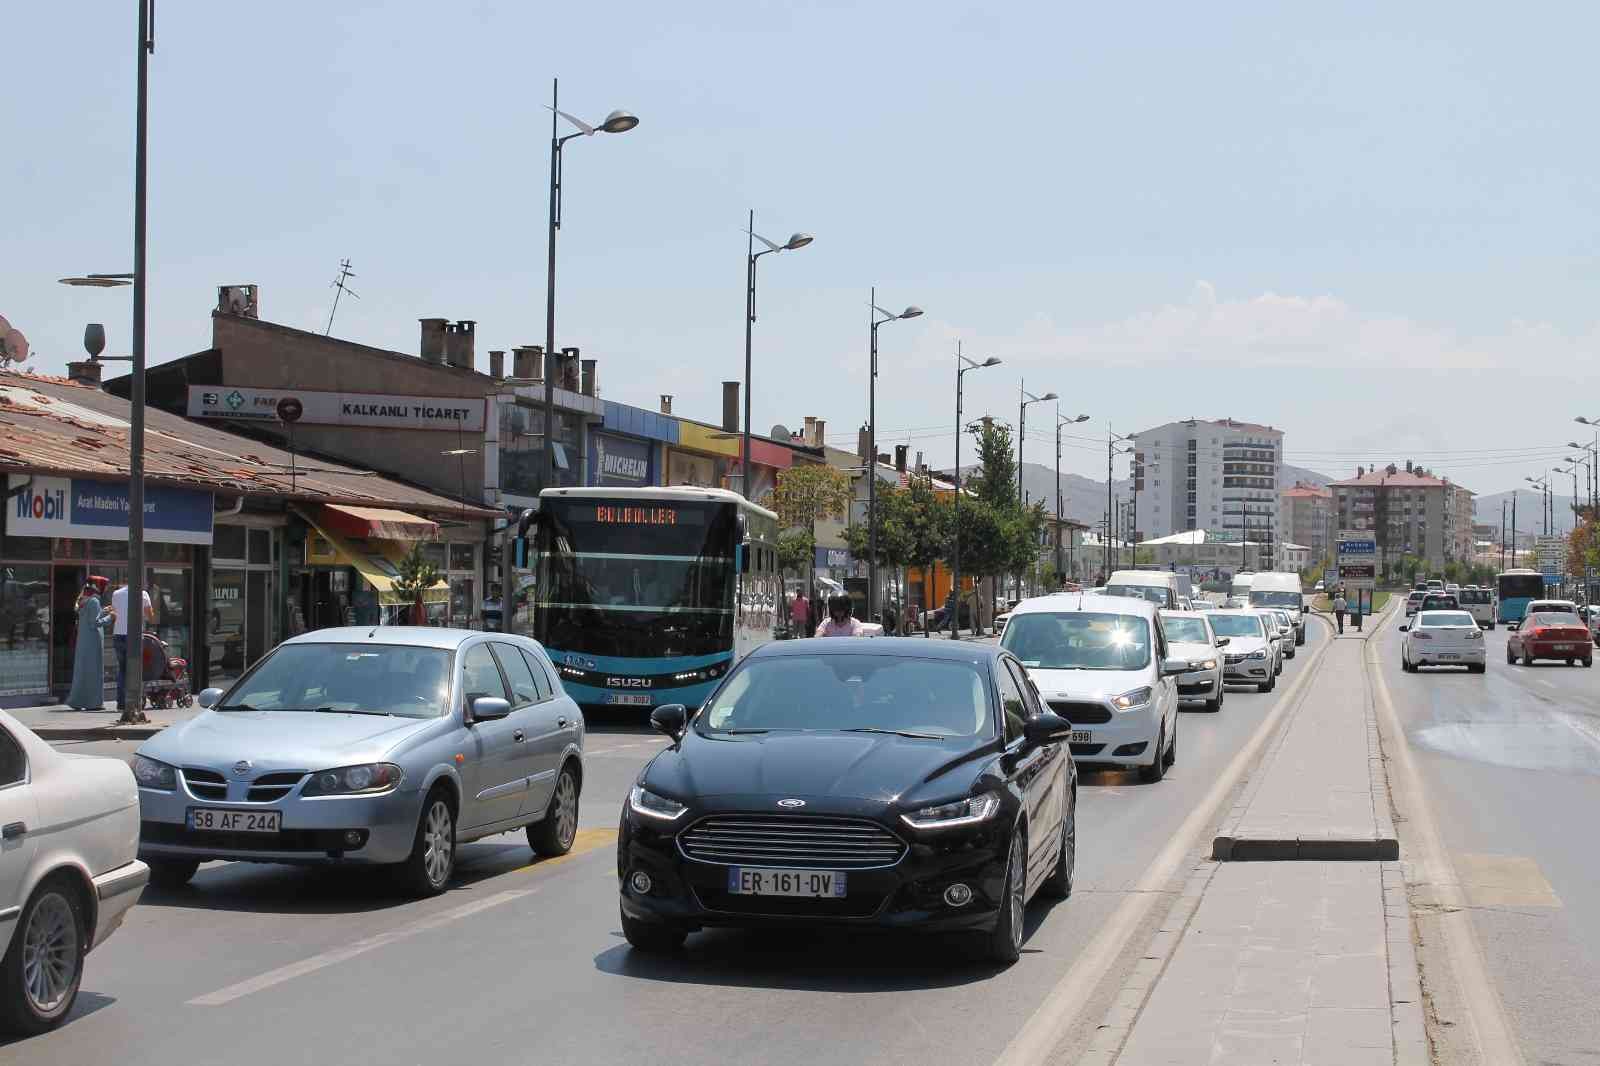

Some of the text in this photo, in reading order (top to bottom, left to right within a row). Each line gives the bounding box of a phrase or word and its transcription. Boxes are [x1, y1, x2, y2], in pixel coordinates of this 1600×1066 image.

[342, 403, 409, 417] KALKANLI
[605, 454, 648, 478] MICHELIN
[17, 488, 64, 520] Mobil
[607, 678, 652, 687] ISUZU
[195, 812, 275, 829] 58 AF 244
